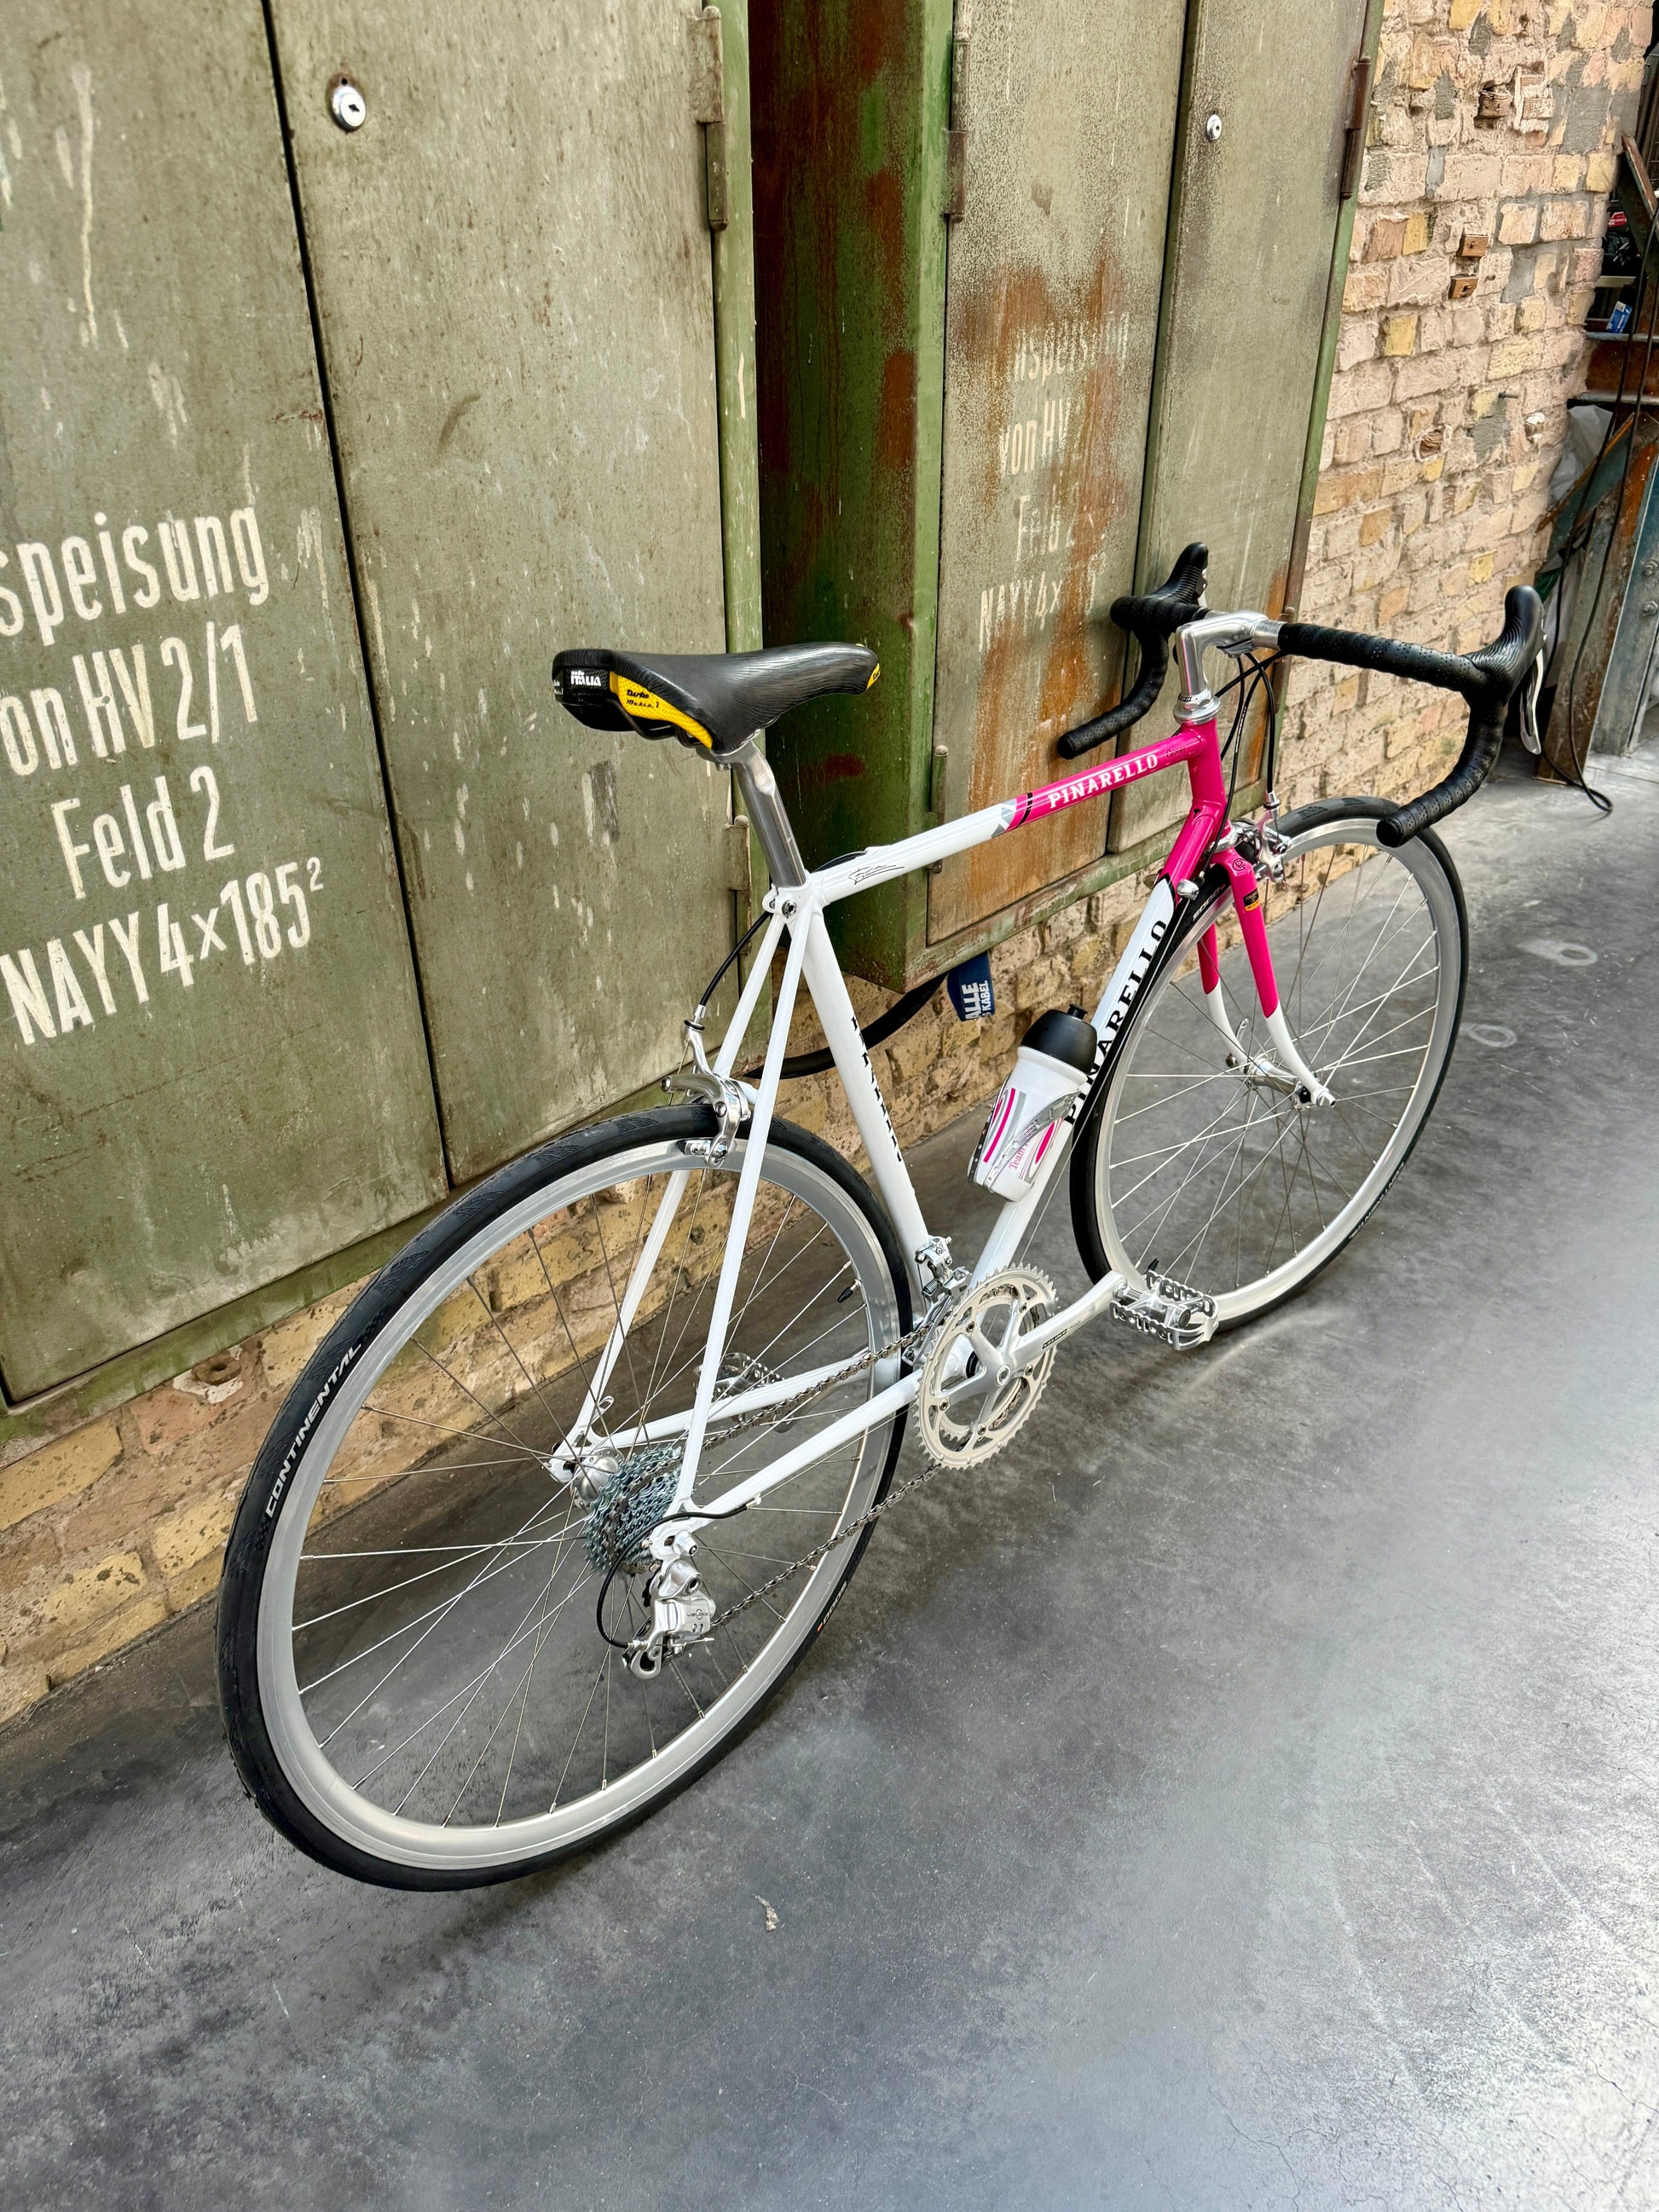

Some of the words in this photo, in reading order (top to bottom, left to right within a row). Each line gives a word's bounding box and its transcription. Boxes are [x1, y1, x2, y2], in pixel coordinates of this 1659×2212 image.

[0, 687, 78, 775] on
[72, 644, 155, 759] HV
[160, 621, 257, 743] 2/1
[570, 675, 601, 686] ITALIA
[51, 775, 186, 899] Feld
[190, 765, 234, 861] 2
[1047, 754, 1159, 809] PINARELLO
[0, 912, 149, 1046] NAYY
[979, 980, 991, 1012] KABEL
[265, 1343, 361, 1519] CONTINENTAL
